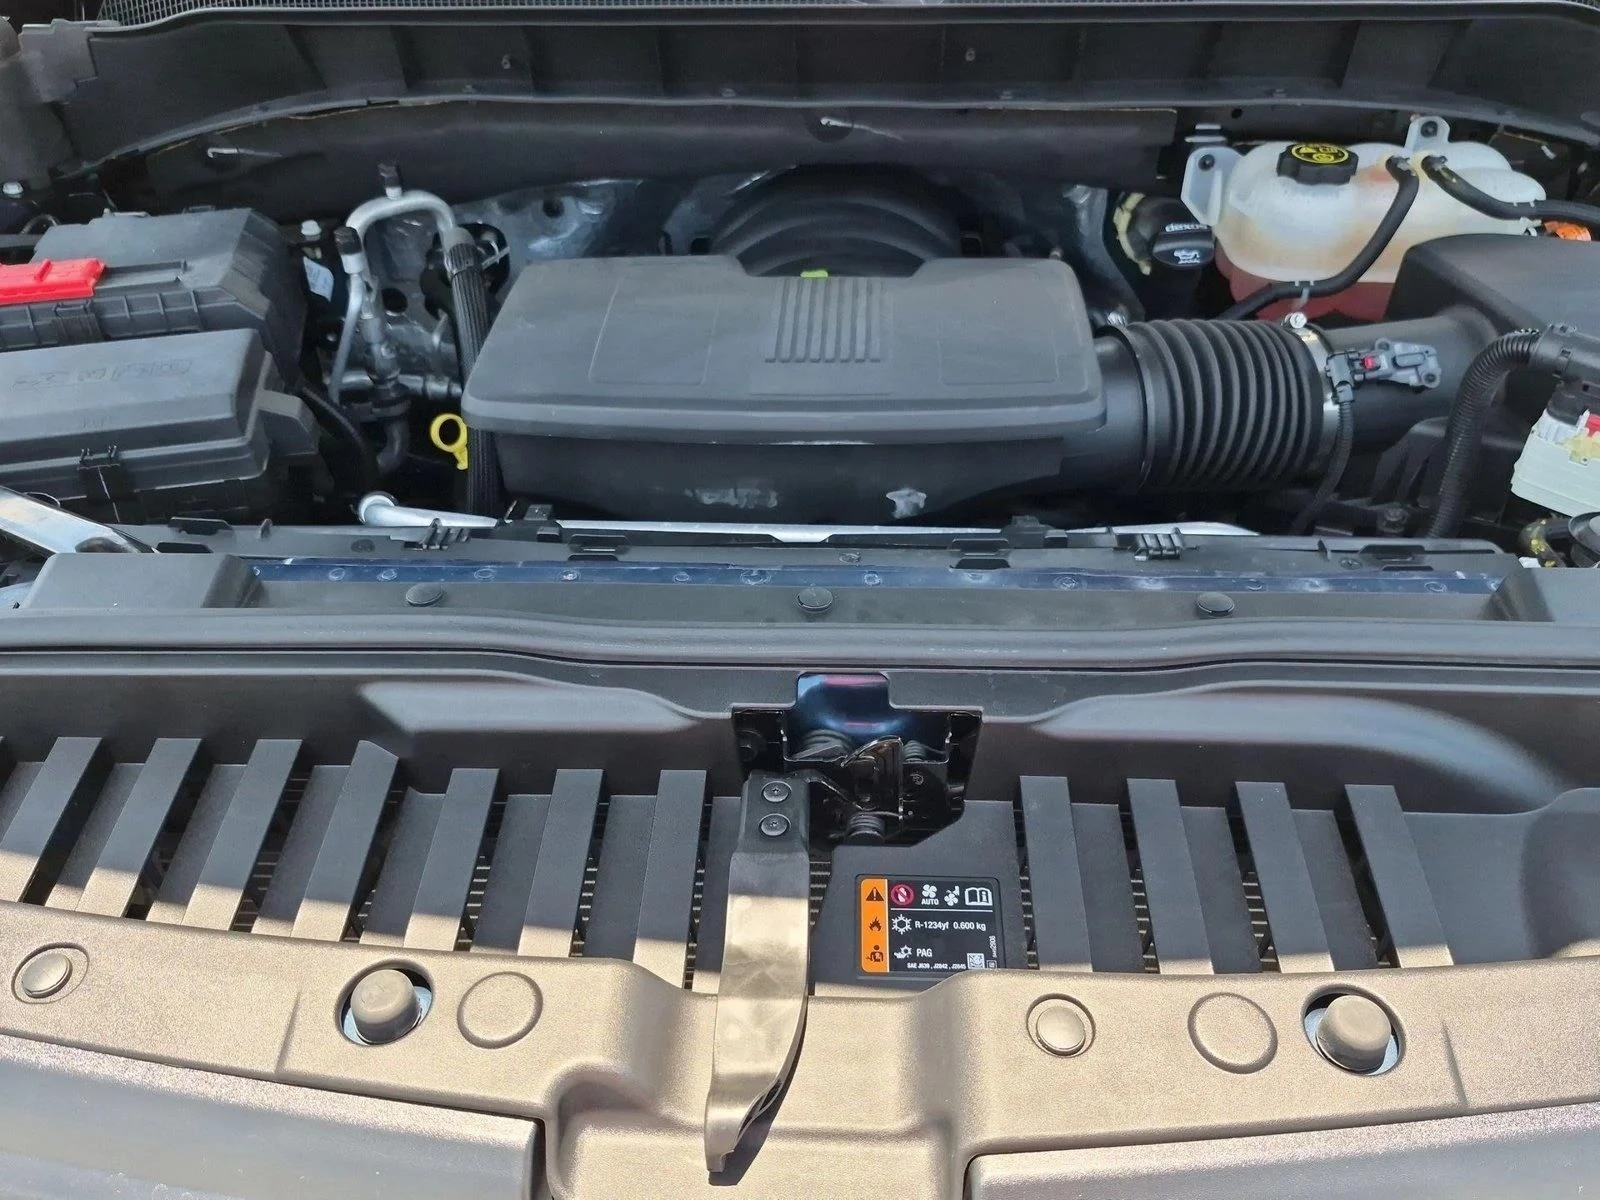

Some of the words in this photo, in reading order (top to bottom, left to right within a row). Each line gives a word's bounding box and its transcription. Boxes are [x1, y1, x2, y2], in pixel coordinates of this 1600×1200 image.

[914, 920, 949, 931] R-1234yf
[953, 921, 975, 930] 0.600
[976, 921, 986, 931] kg
[916, 948, 933, 957] PAG
